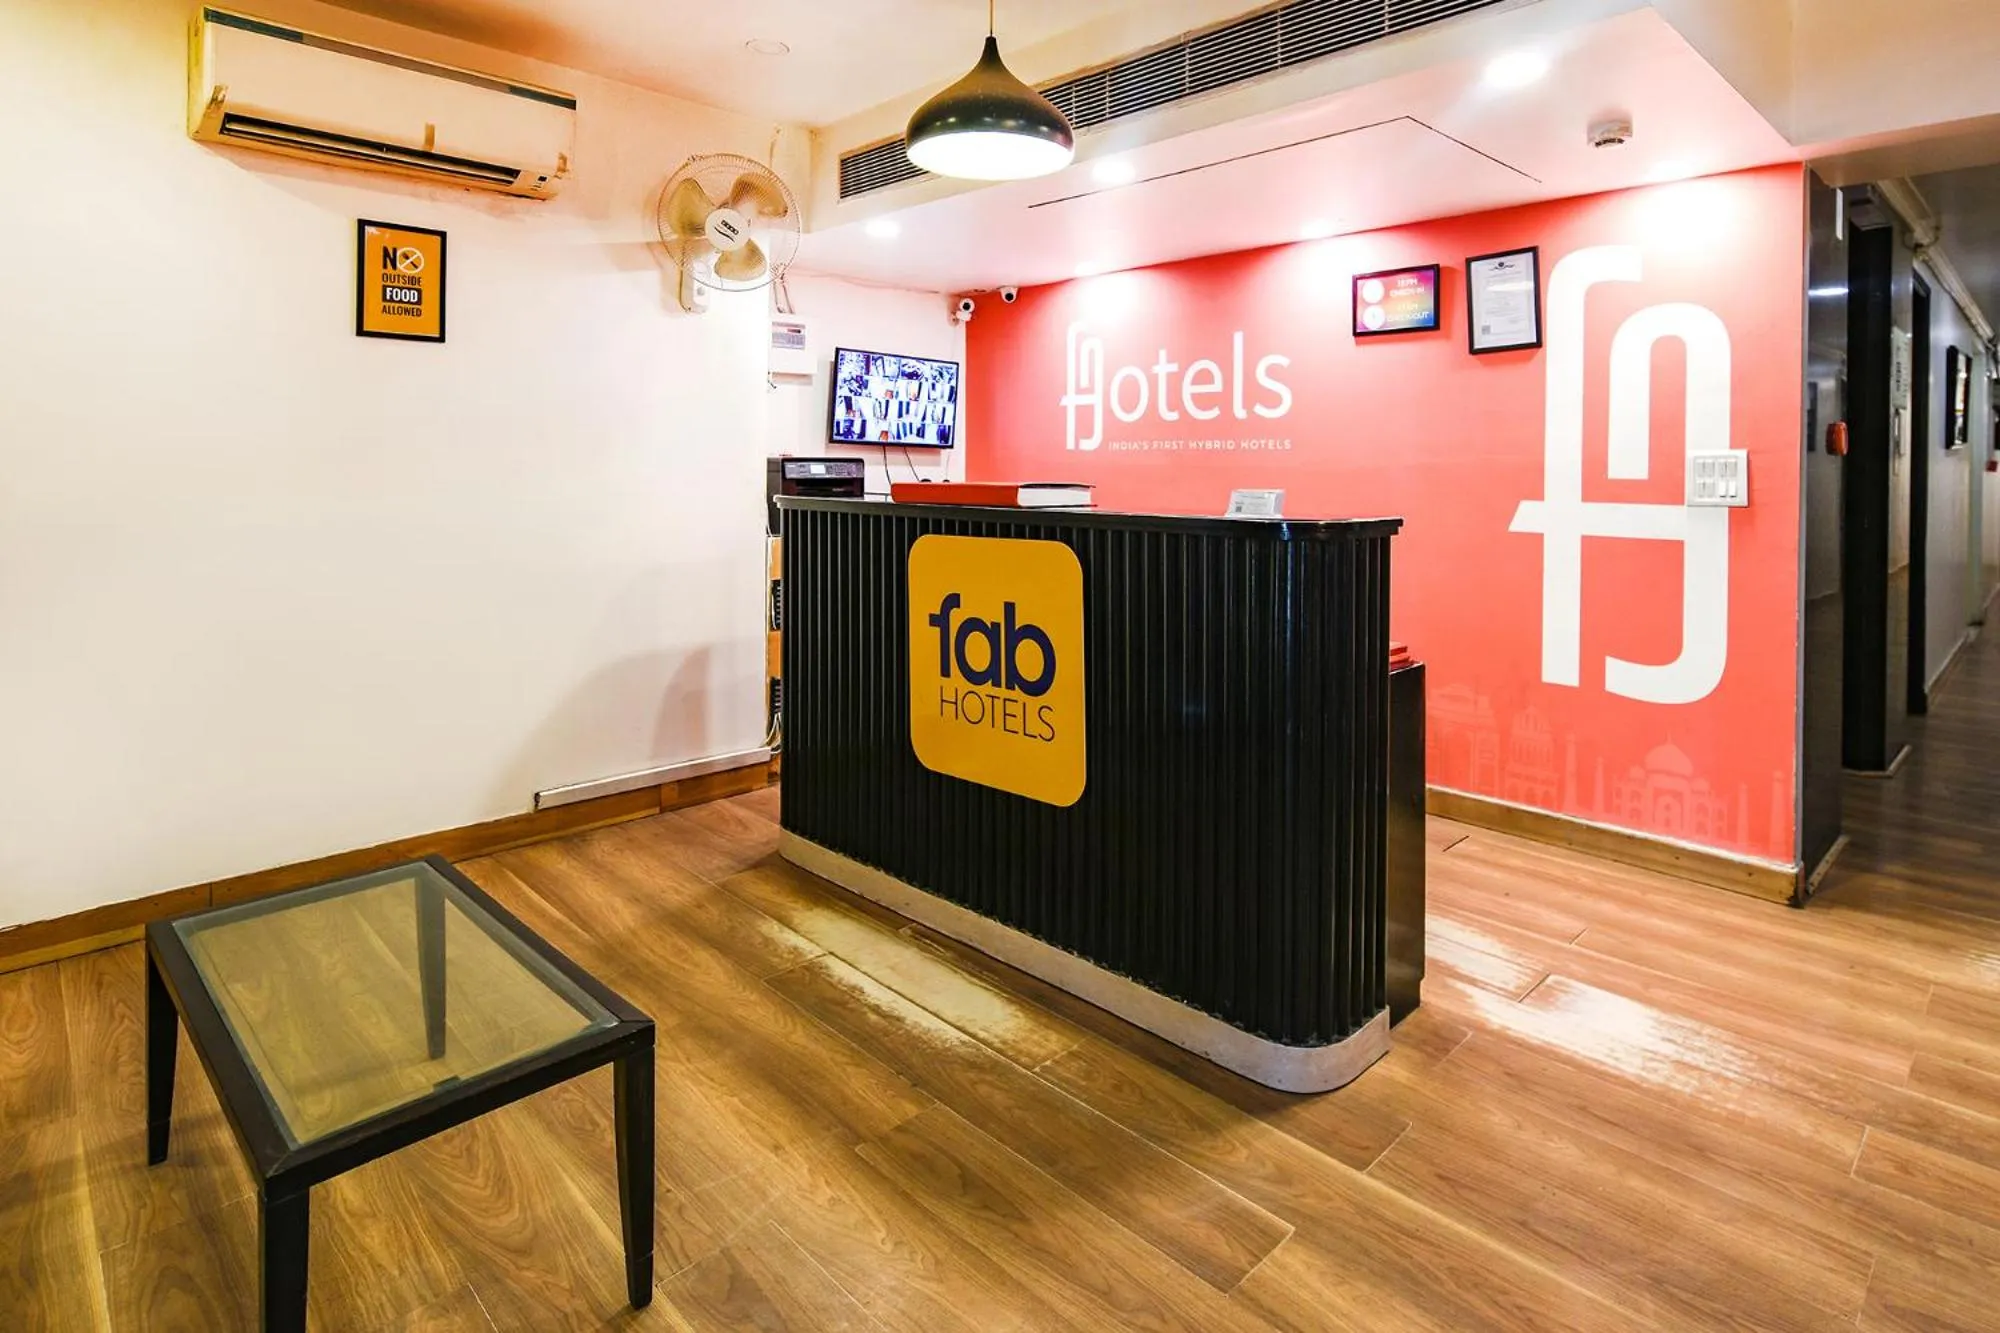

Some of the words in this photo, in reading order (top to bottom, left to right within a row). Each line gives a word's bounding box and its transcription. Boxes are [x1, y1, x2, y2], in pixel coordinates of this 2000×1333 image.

[382, 273, 422, 286] OUTSIDE
[386, 287, 418, 302] FOOD
[382, 305, 422, 317] ALLOWED
[1108, 440, 1150, 451] INDIA'S
[1151, 440, 1184, 451] FIRST
[1188, 439, 1235, 450] HYBRID
[1240, 438, 1292, 450] HOTELS
[928, 592, 1056, 697] fab
[940, 685, 1056, 742] HOTELS
